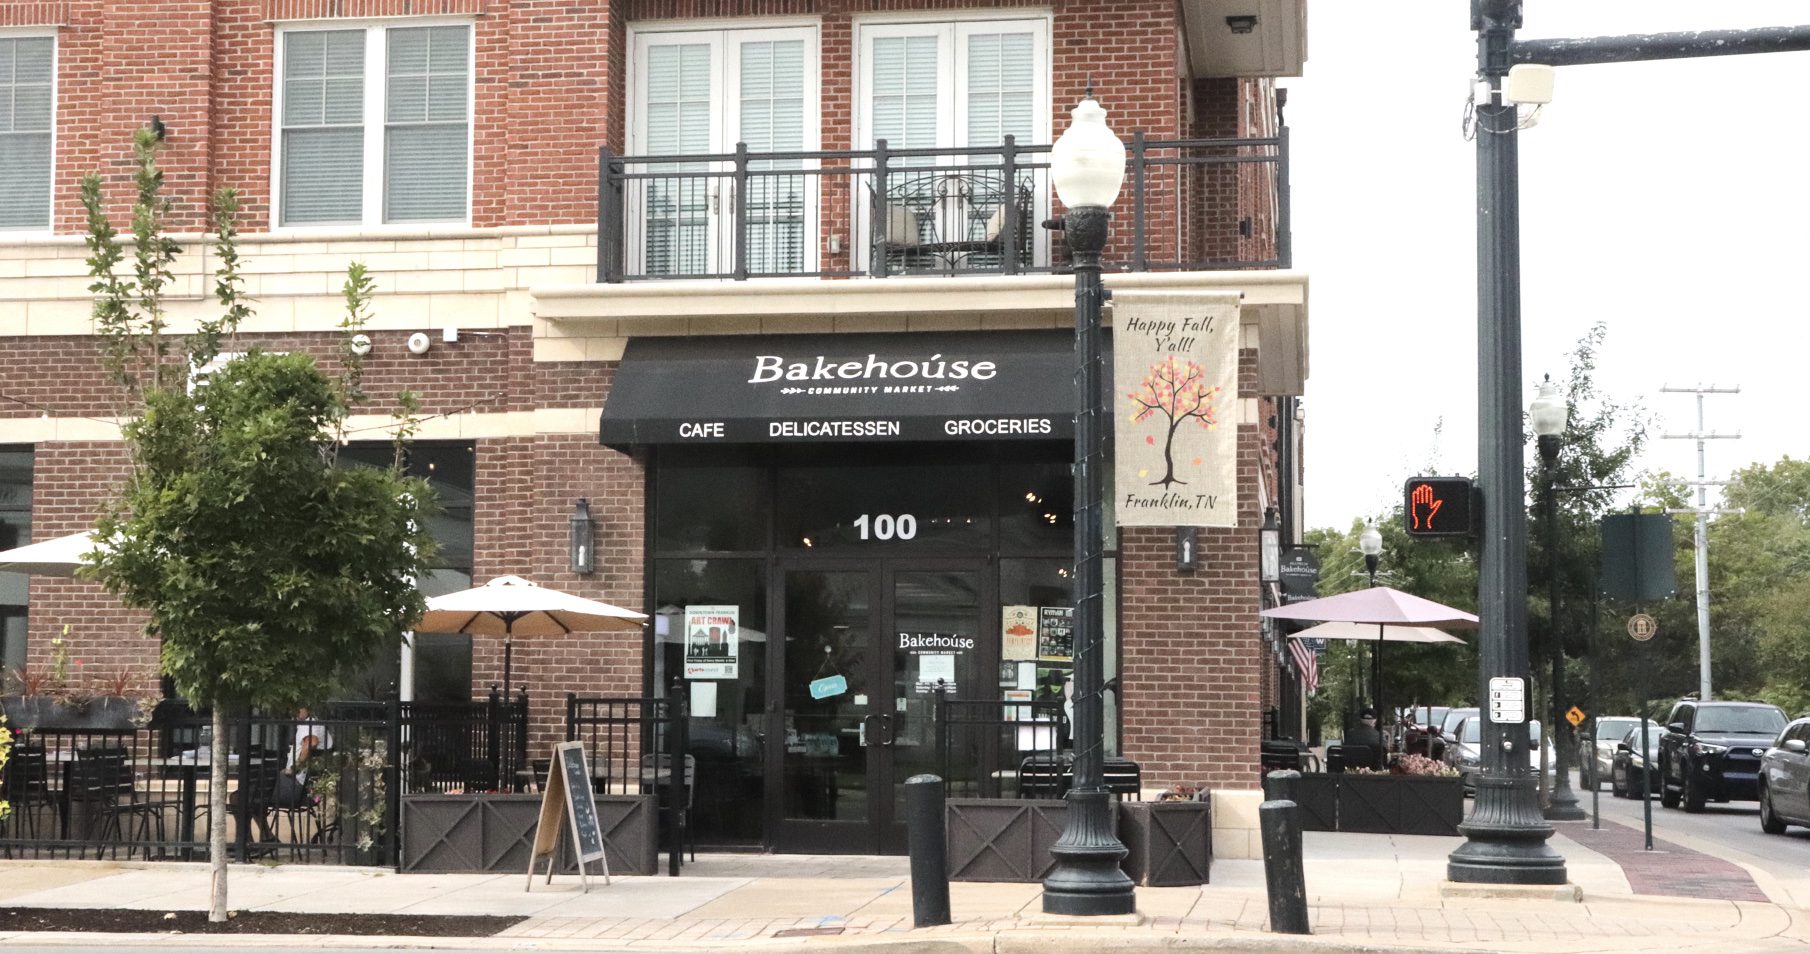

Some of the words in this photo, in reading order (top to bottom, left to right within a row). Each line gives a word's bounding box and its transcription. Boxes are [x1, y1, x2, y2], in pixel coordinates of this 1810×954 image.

[1126, 317, 1176, 336] Happy
[1182, 316, 1214, 333] Fall,
[1155, 337, 1195, 353] Y'all!
[807, 386, 879, 395] COMMUNITY
[883, 385, 933, 394] MARKET
[679, 422, 725, 438] CAFE
[769, 420, 900, 437] DELICATESSEN
[944, 418, 1052, 435] GROCERIES
[853, 513, 917, 540] 100
[691, 616, 705, 625] ART
